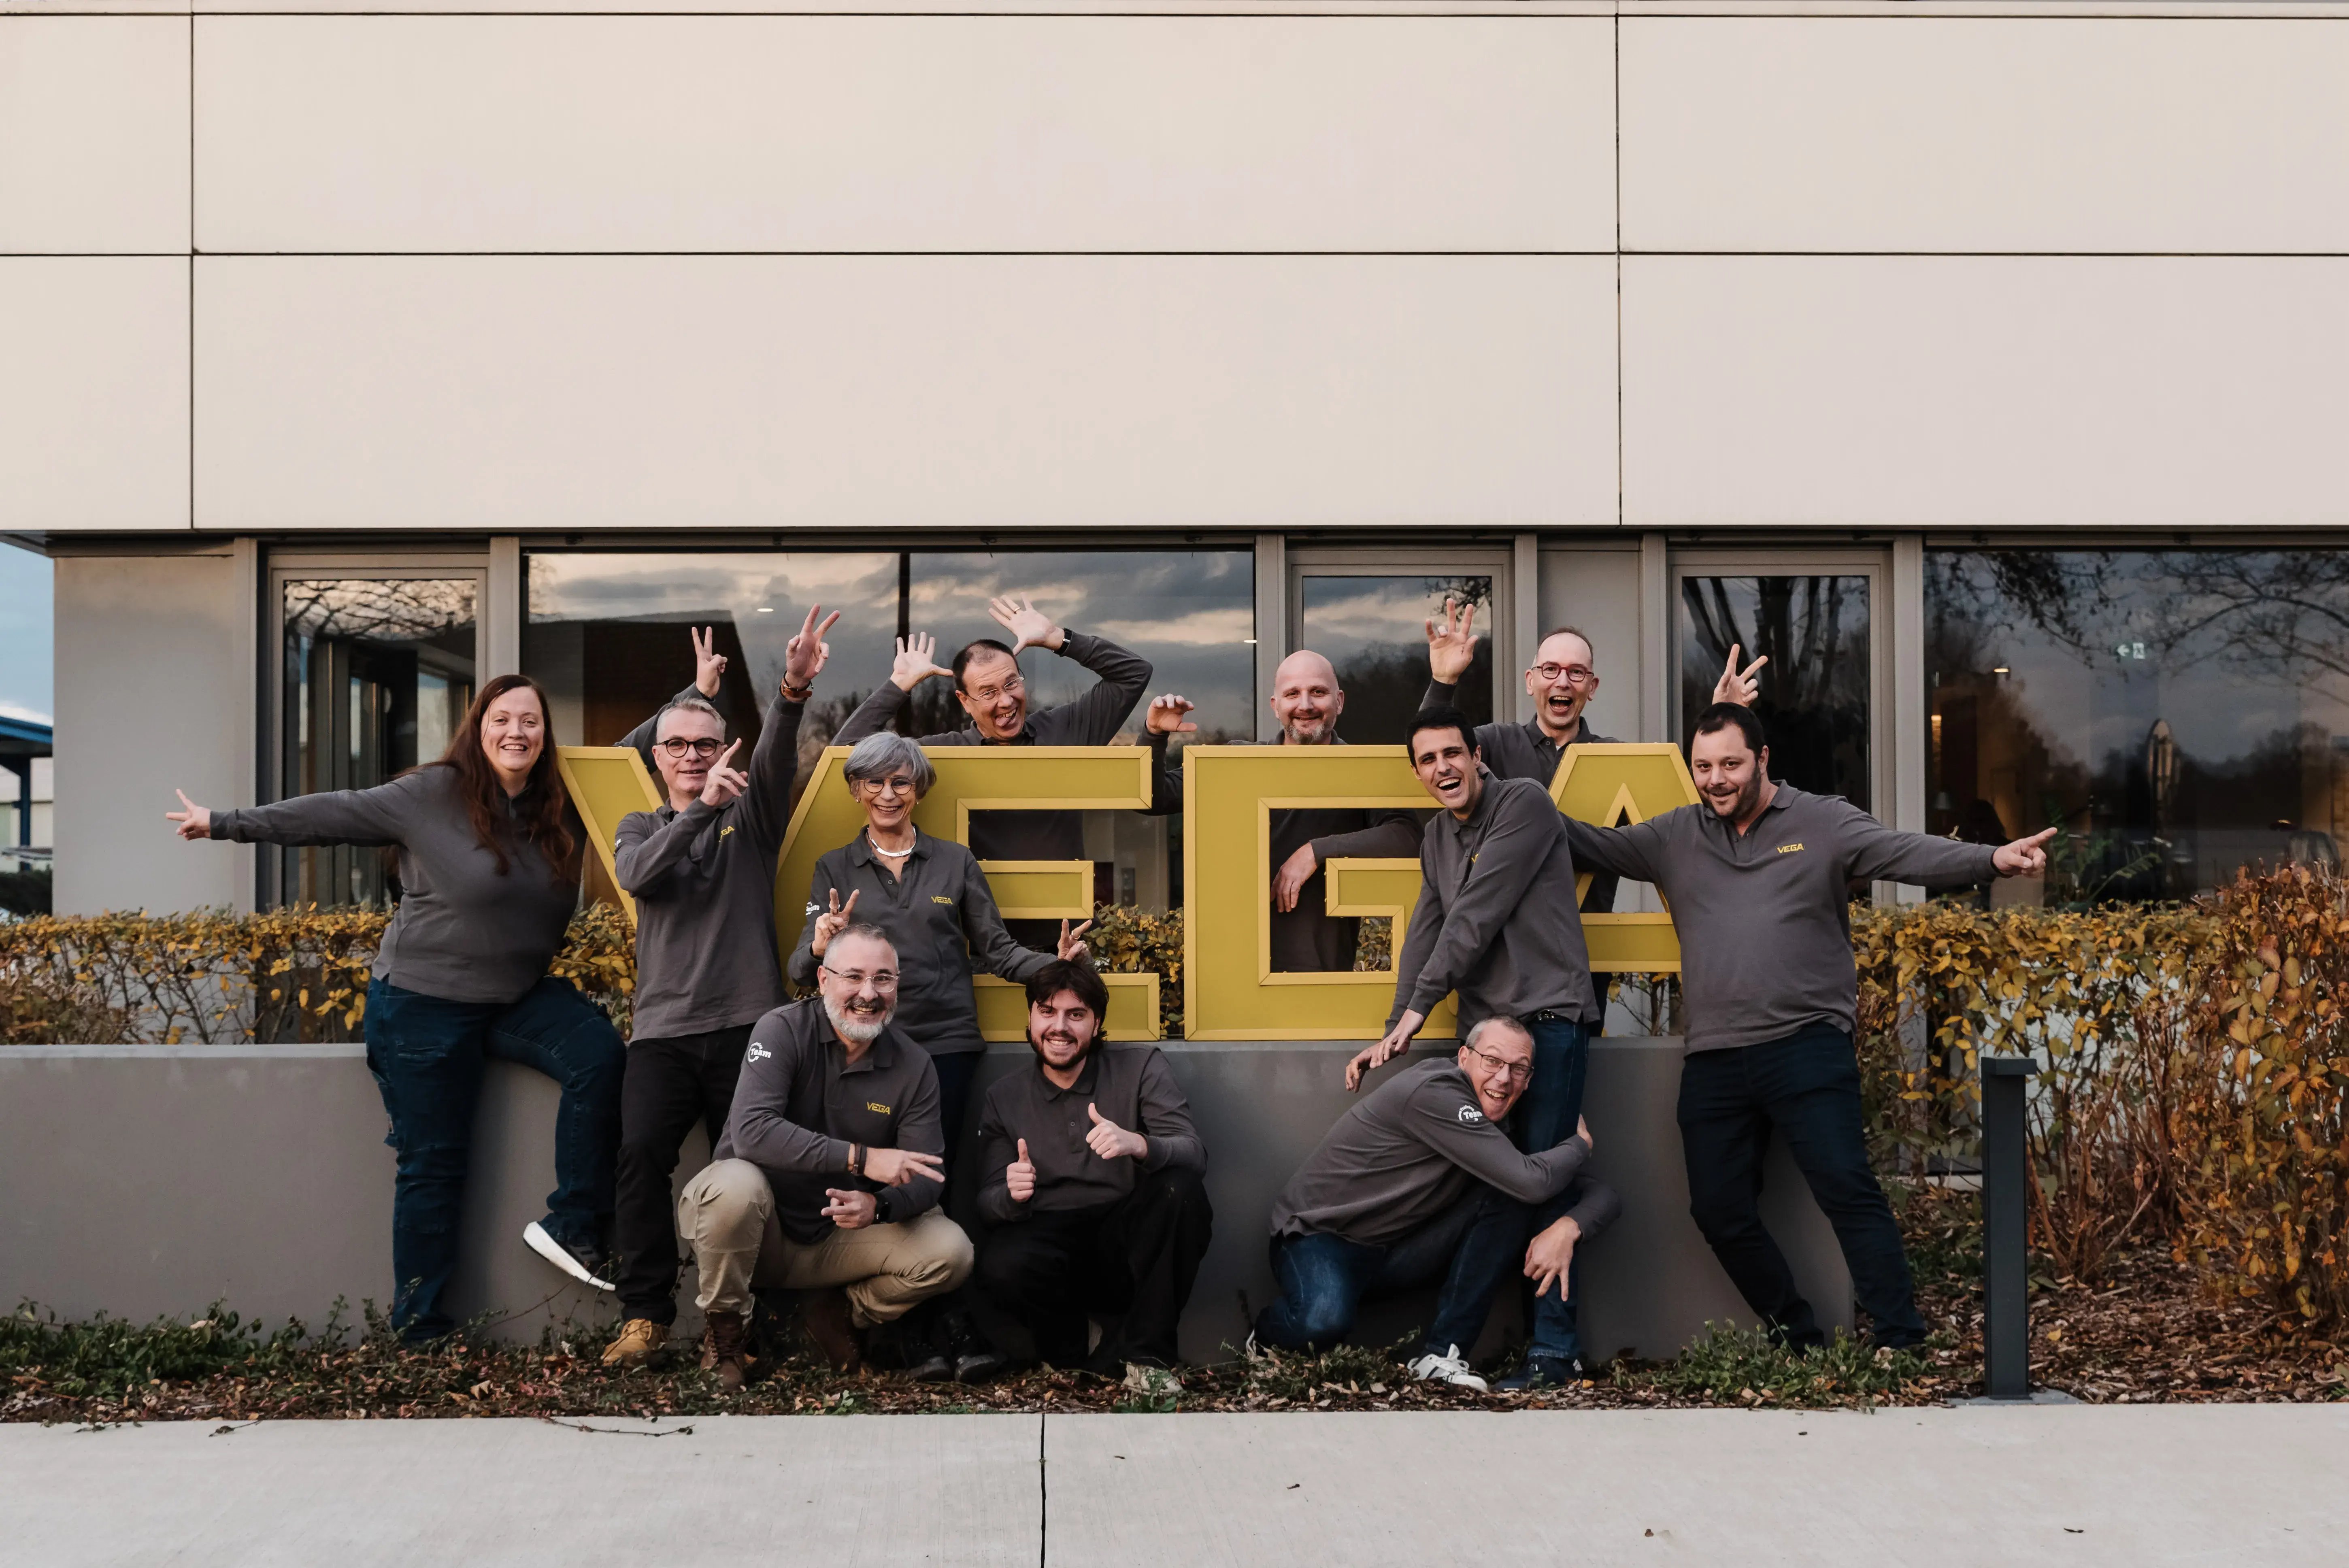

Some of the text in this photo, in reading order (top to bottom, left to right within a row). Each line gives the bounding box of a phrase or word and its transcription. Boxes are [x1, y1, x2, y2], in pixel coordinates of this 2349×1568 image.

[1777, 843, 1804, 853] VEGA
[931, 896, 953, 905] VEGA
[751, 1048, 772, 1058] Team
[867, 1102, 890, 1115] VEGA
